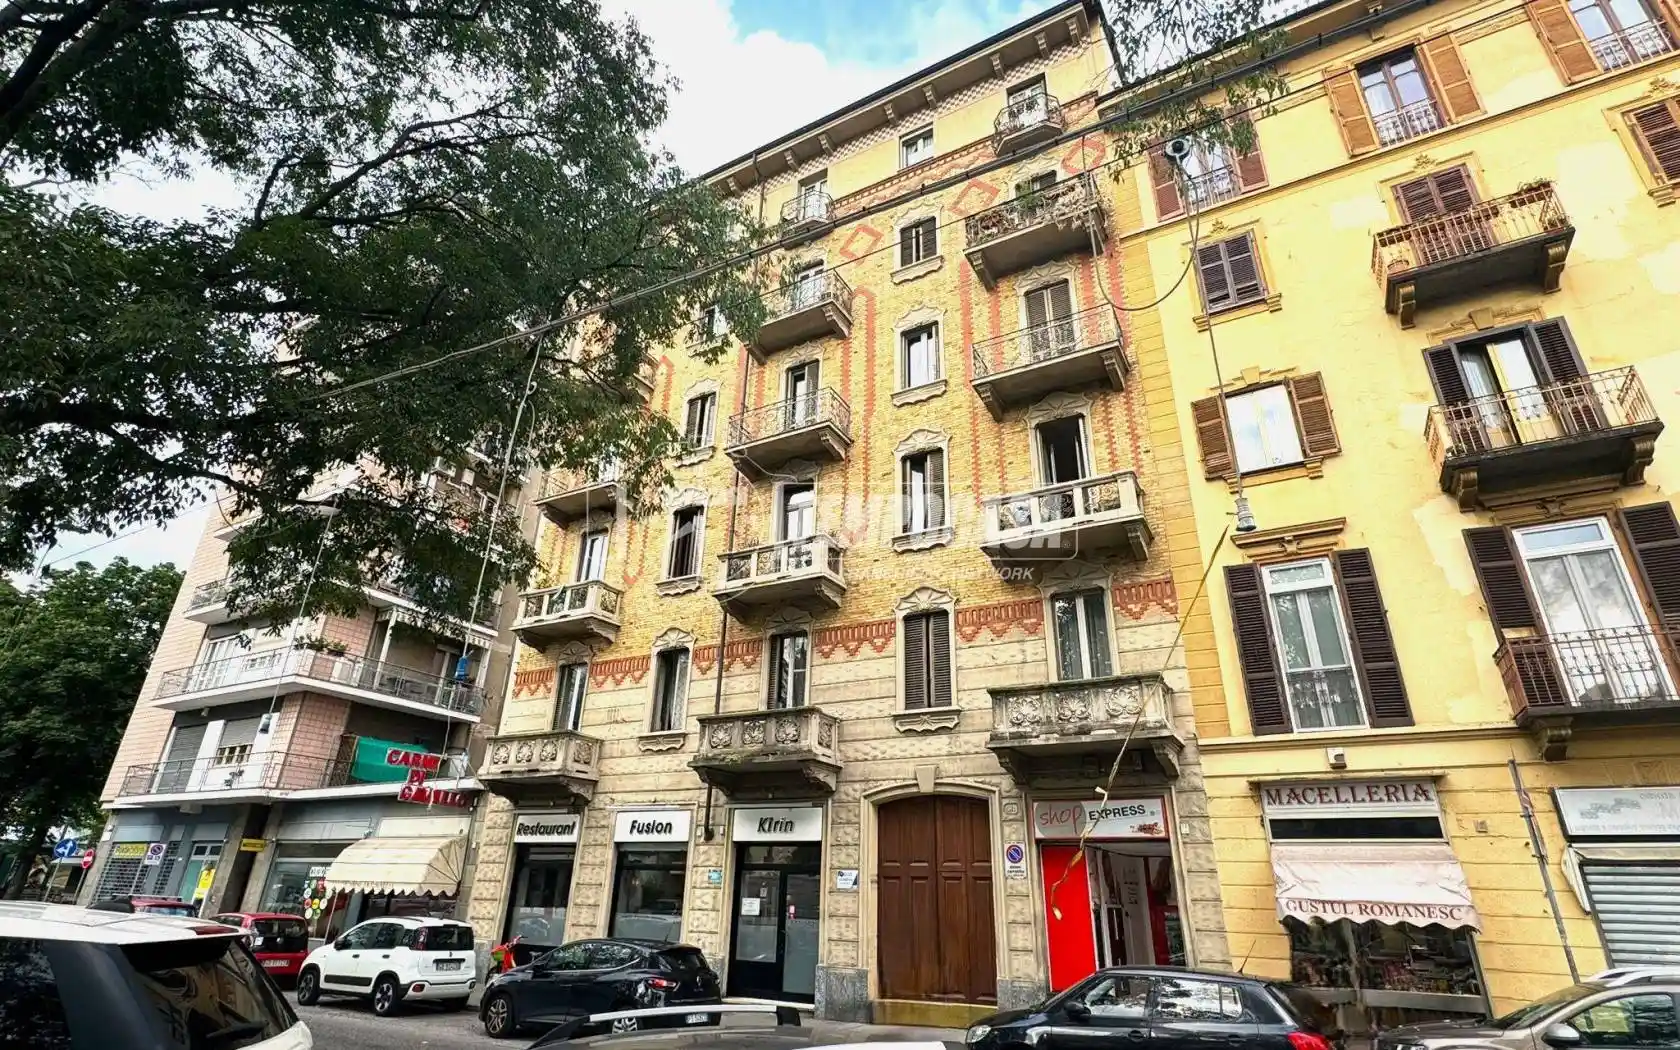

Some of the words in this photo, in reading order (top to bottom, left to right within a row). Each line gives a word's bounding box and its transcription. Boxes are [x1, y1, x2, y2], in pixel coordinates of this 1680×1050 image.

[1264, 783, 1432, 806] MACELLERIA
[516, 820, 577, 836] Restaurant
[629, 819, 673, 835] Fusion
[757, 816, 794, 834] Kirin
[1039, 803, 1083, 836] shop
[1088, 804, 1146, 821] EXPRESS
[1286, 899, 1354, 916] GUSTUL
[1358, 902, 1463, 921] ROMANESC
